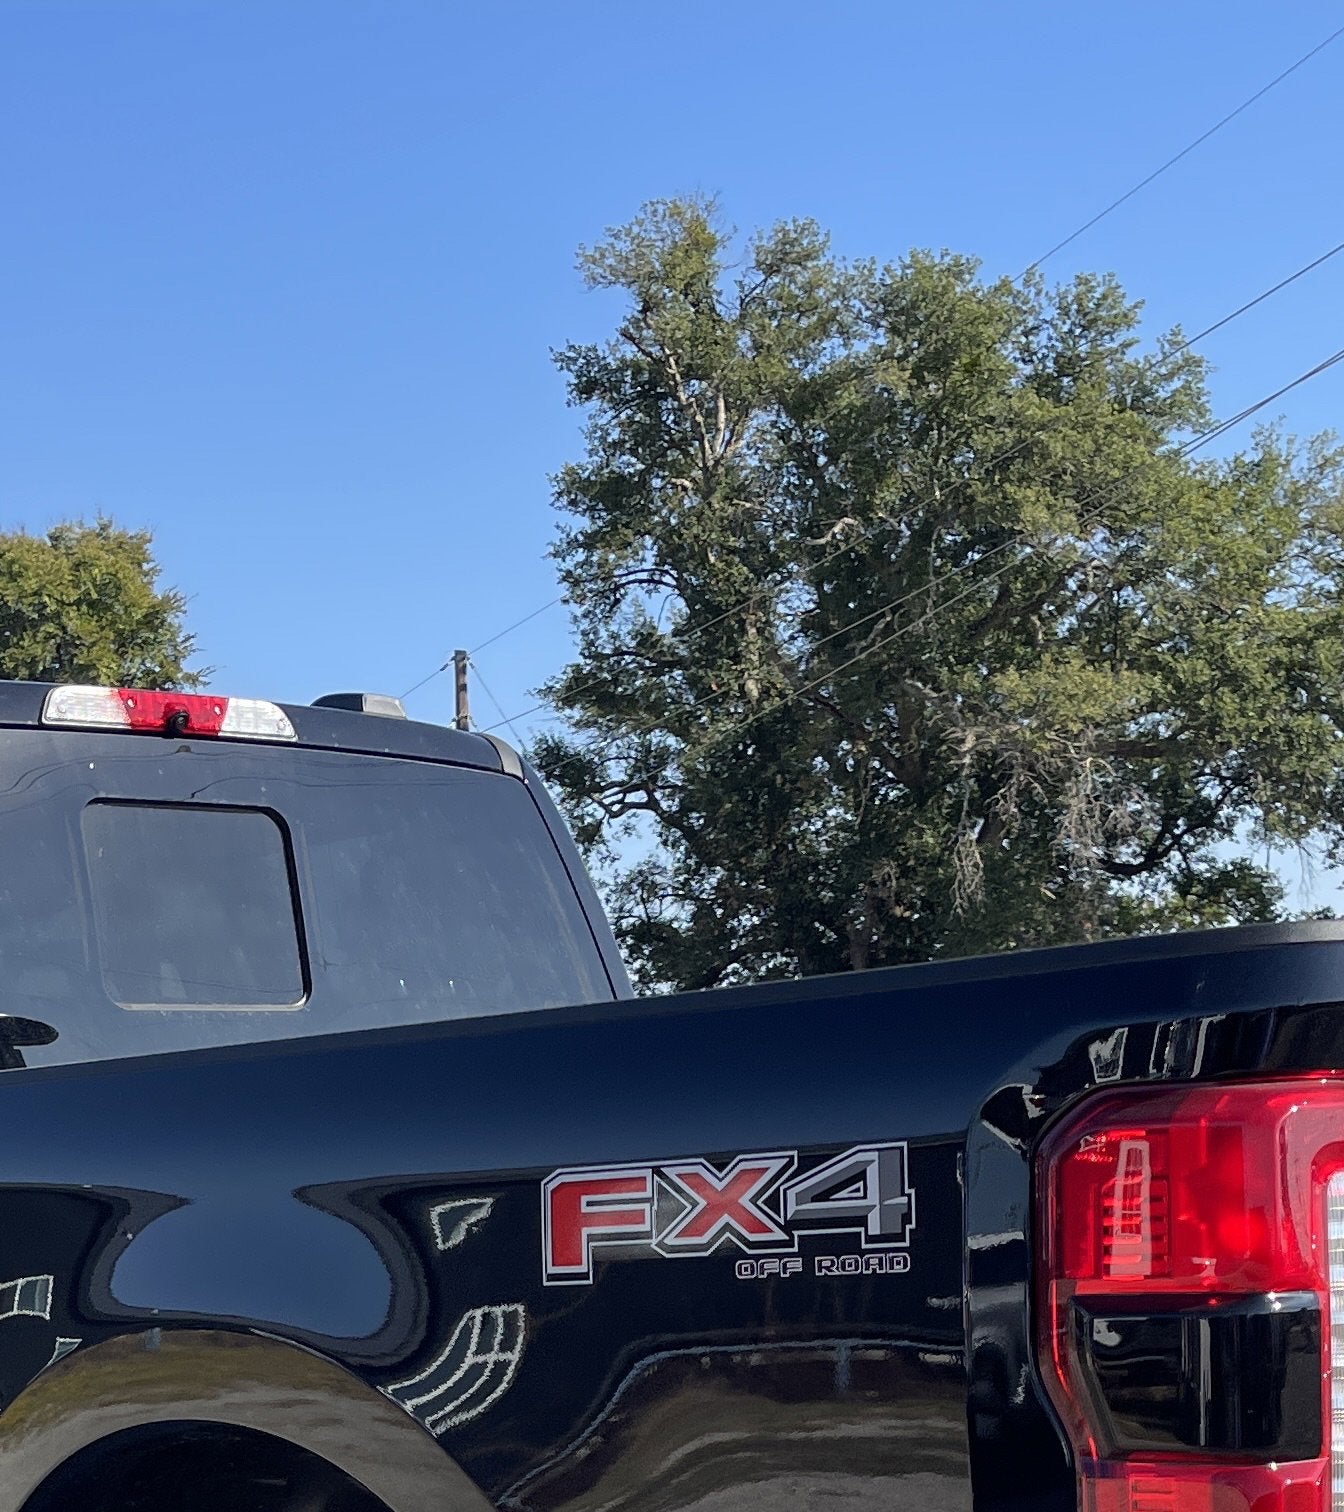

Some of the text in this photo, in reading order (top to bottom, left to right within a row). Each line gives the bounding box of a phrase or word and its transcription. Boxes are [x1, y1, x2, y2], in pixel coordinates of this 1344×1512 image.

[541, 1141, 915, 1286] FX4
[735, 1252, 911, 1279] OFF ROAD
